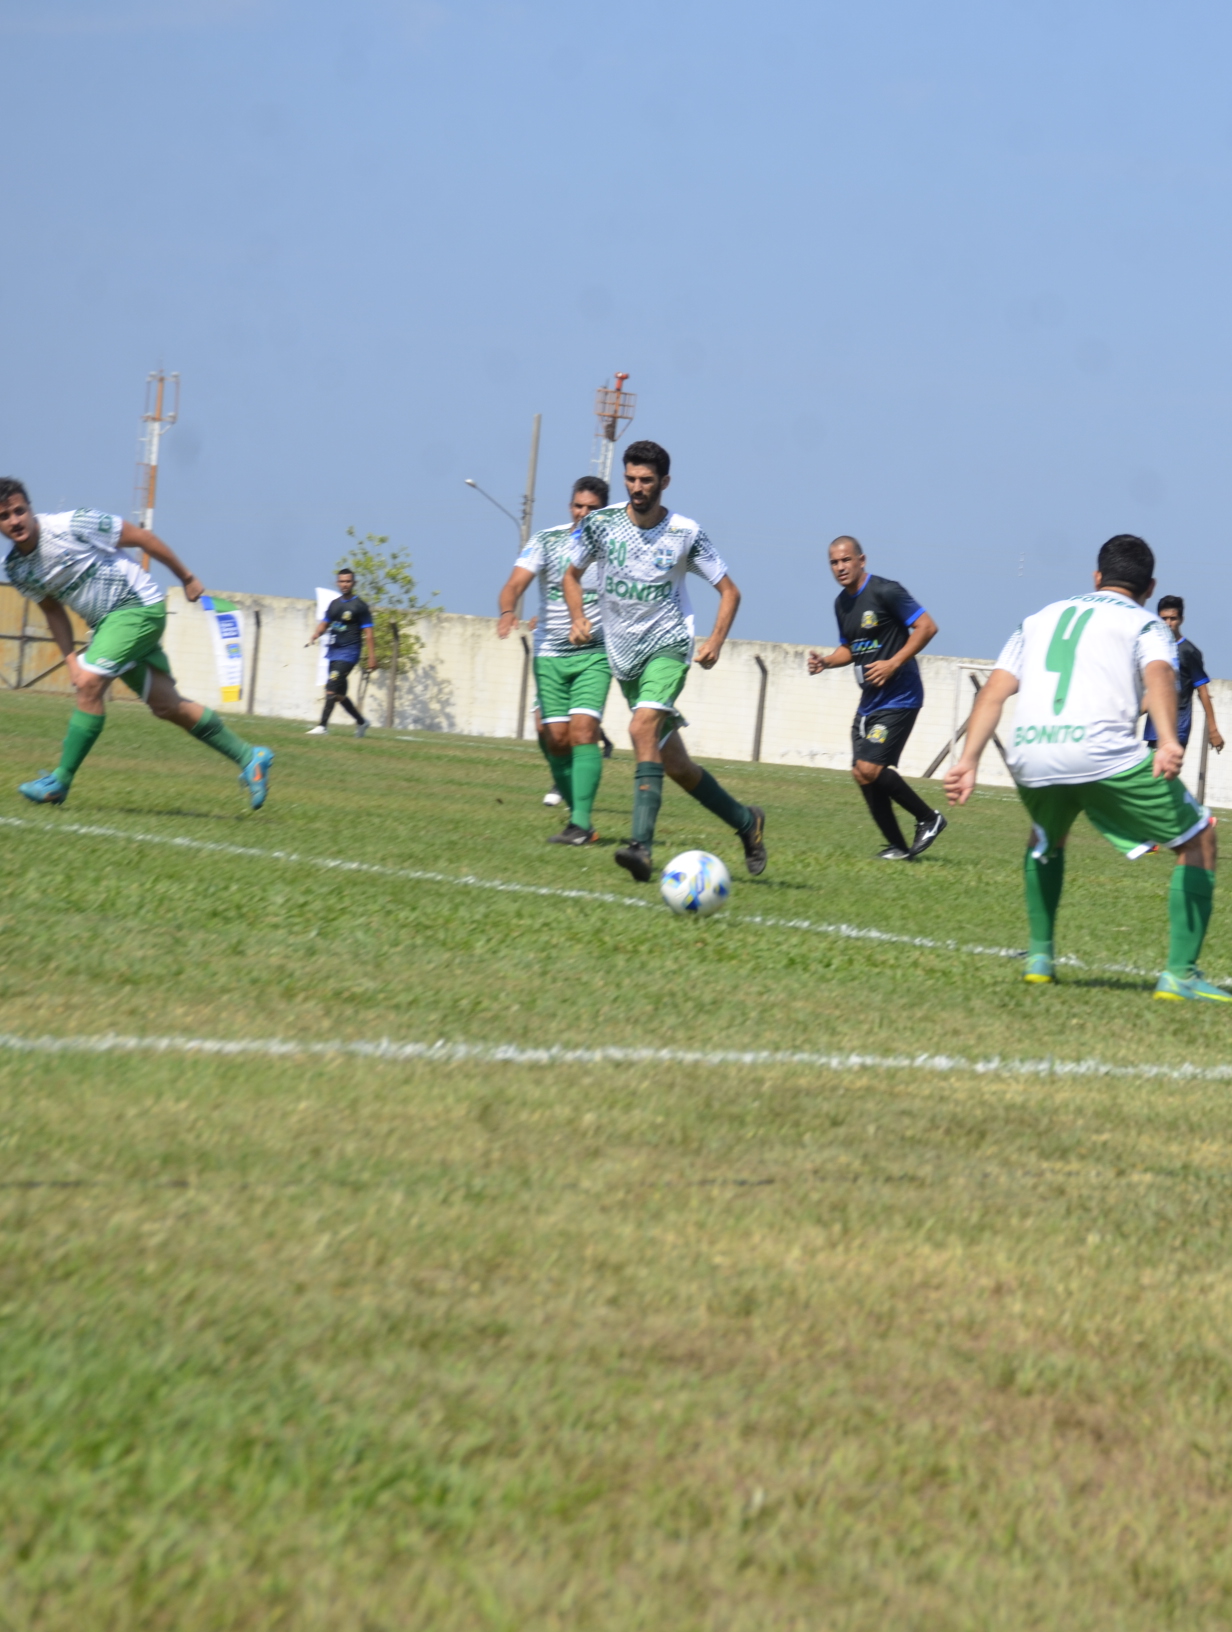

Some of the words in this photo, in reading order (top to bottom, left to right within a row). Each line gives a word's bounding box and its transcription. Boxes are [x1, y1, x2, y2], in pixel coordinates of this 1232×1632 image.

[604, 574, 672, 602] BONITO
[1066, 595, 1137, 610] PORTES
[1045, 605, 1096, 716] 4
[1014, 724, 1086, 748] BONITO
